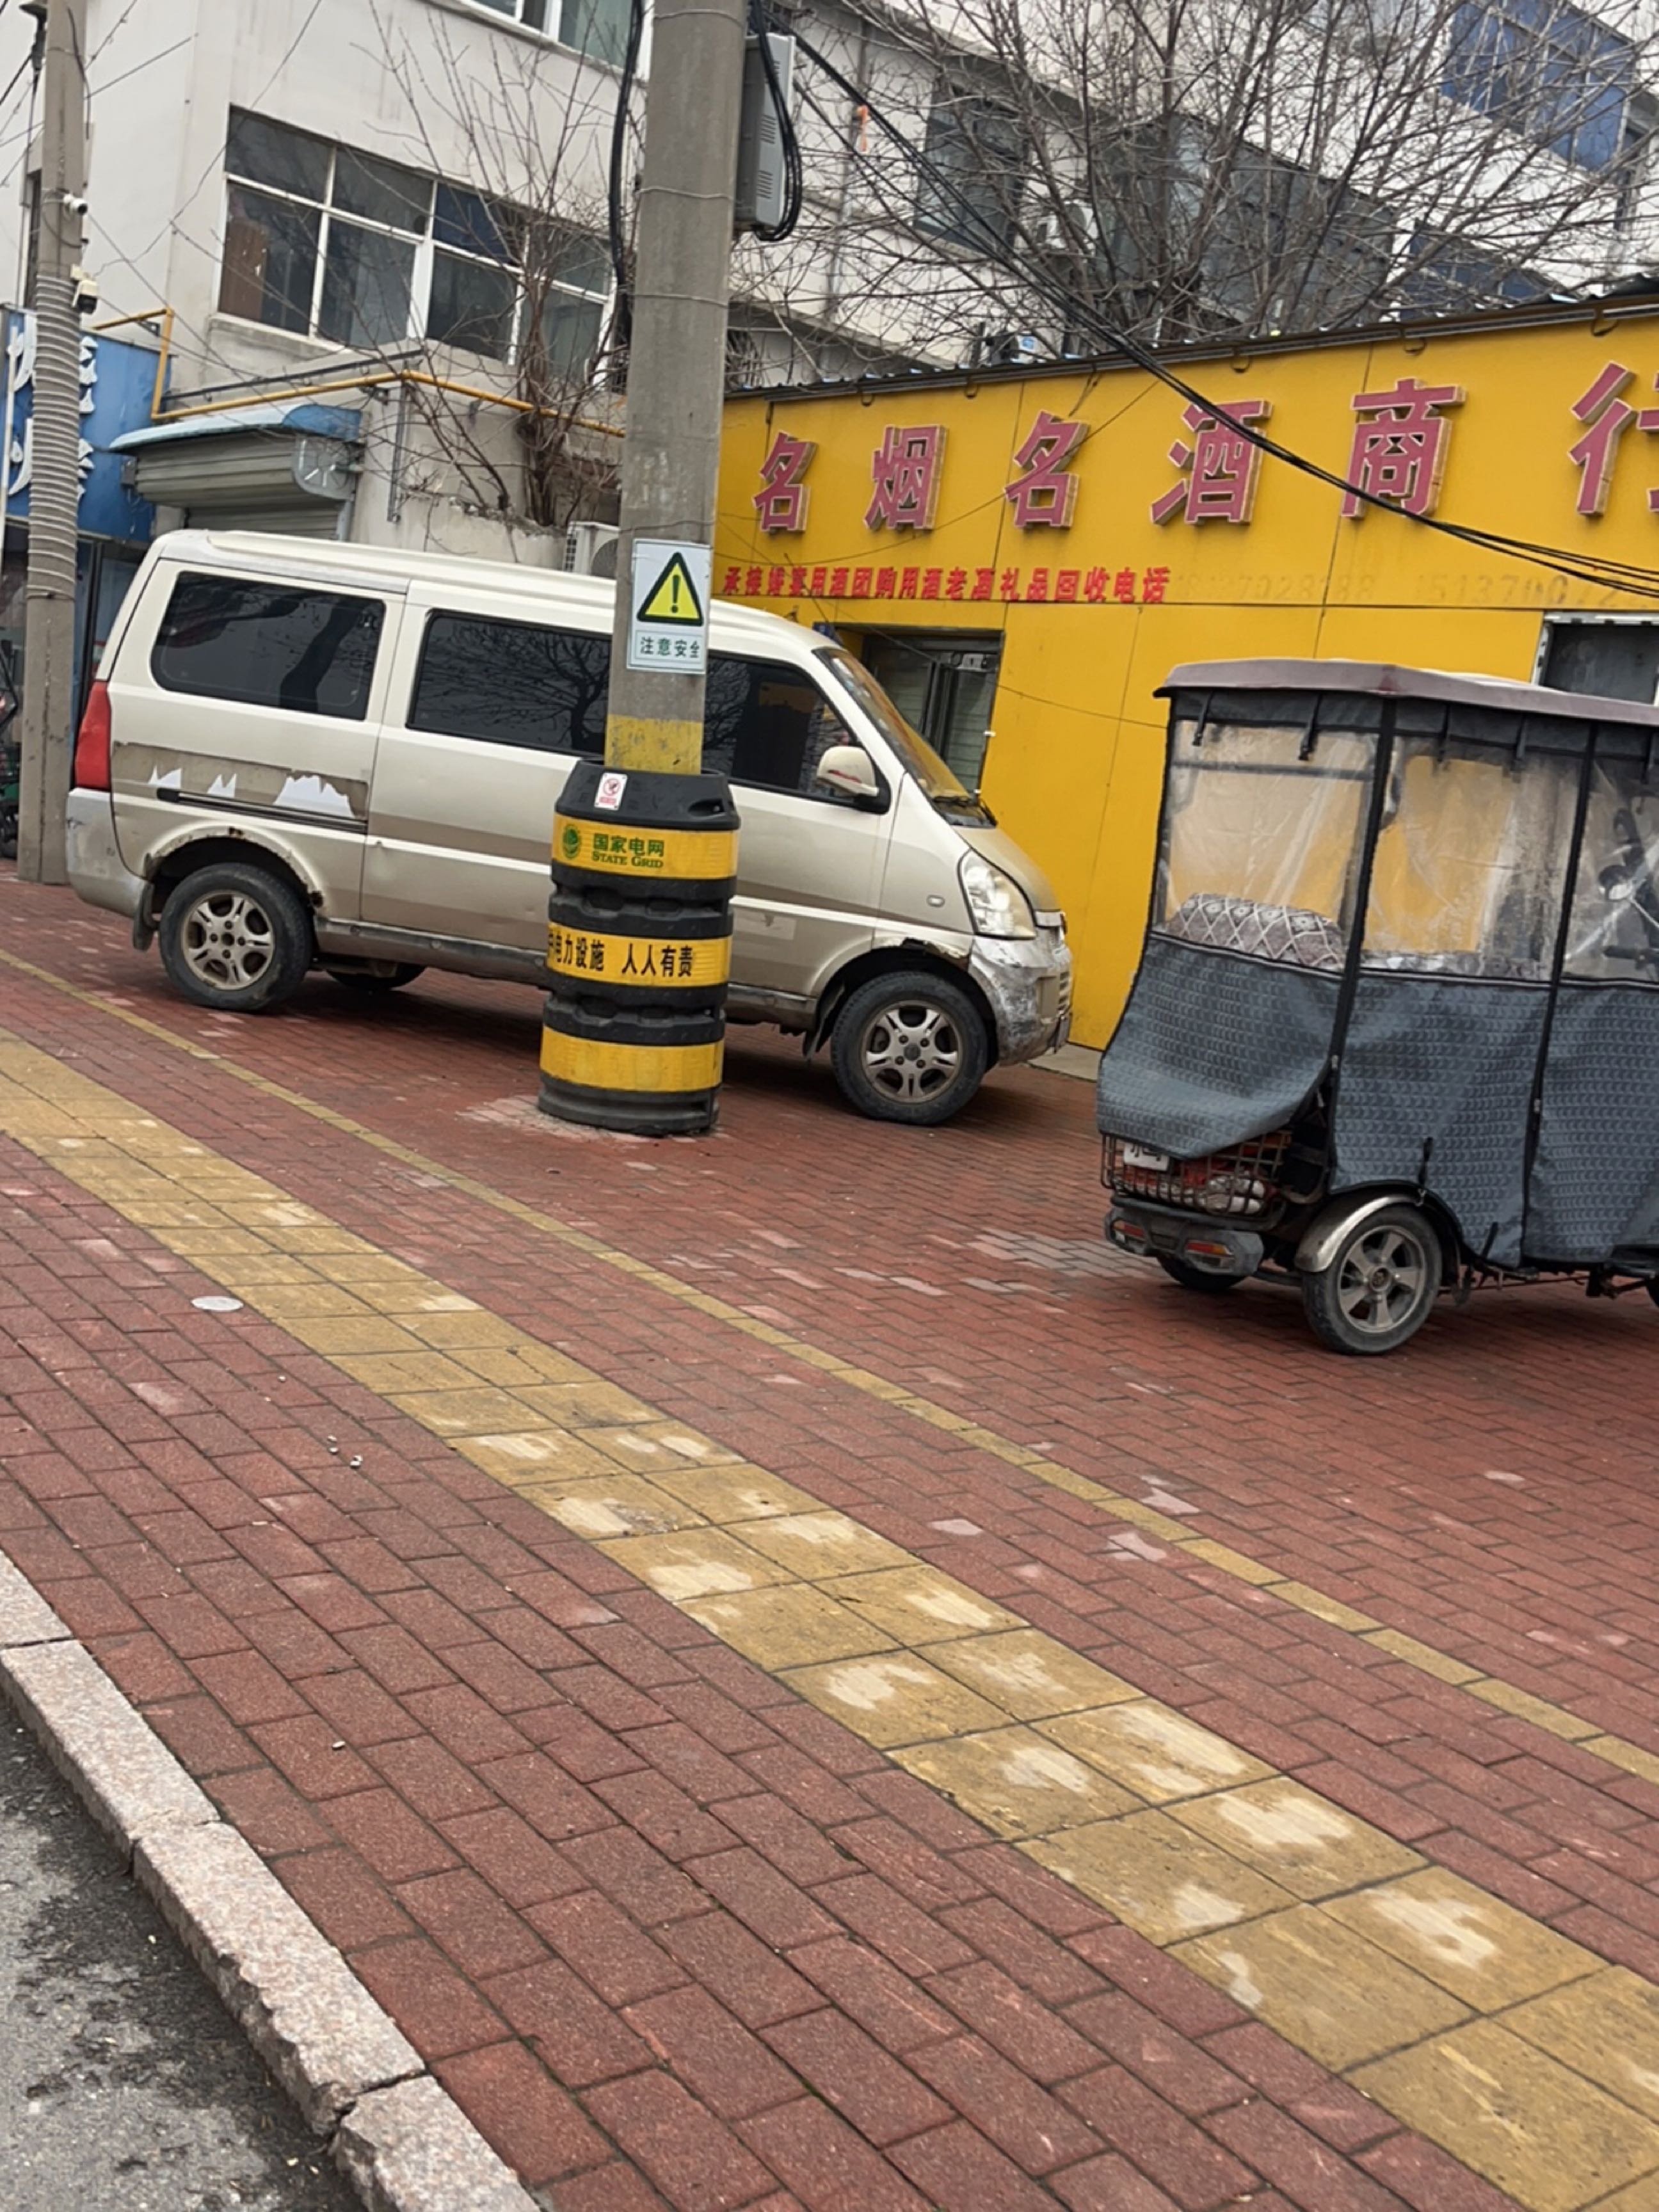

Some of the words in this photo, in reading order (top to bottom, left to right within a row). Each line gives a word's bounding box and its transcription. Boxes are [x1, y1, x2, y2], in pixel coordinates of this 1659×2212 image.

[640, 636, 700, 658] 注意安全
[593, 833, 664, 857] 国家电网
[621, 942, 693, 977] 人人有责
